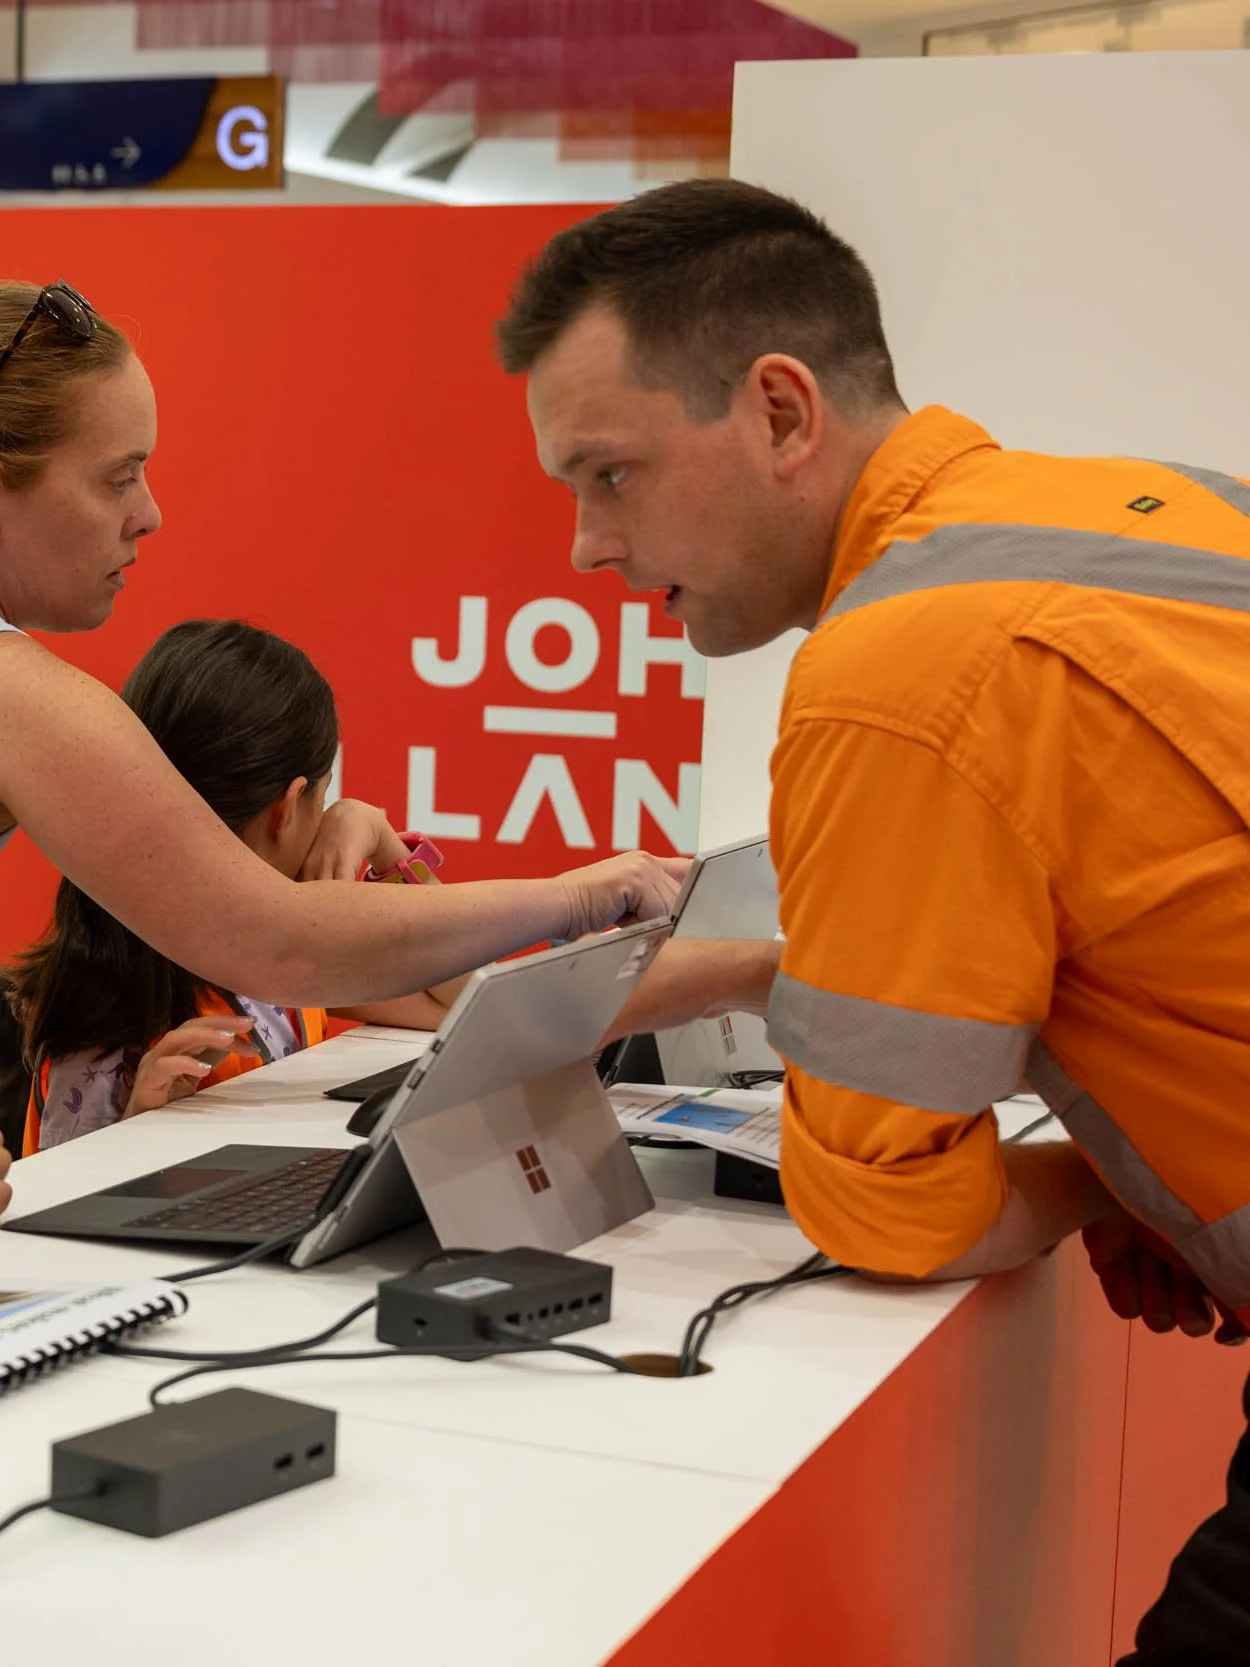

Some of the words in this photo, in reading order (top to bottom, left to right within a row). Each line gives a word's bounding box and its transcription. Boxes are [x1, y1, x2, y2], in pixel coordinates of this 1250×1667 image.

[216, 104, 268, 171] G
[411, 595, 706, 699] JOH
[324, 741, 702, 856] LAN
